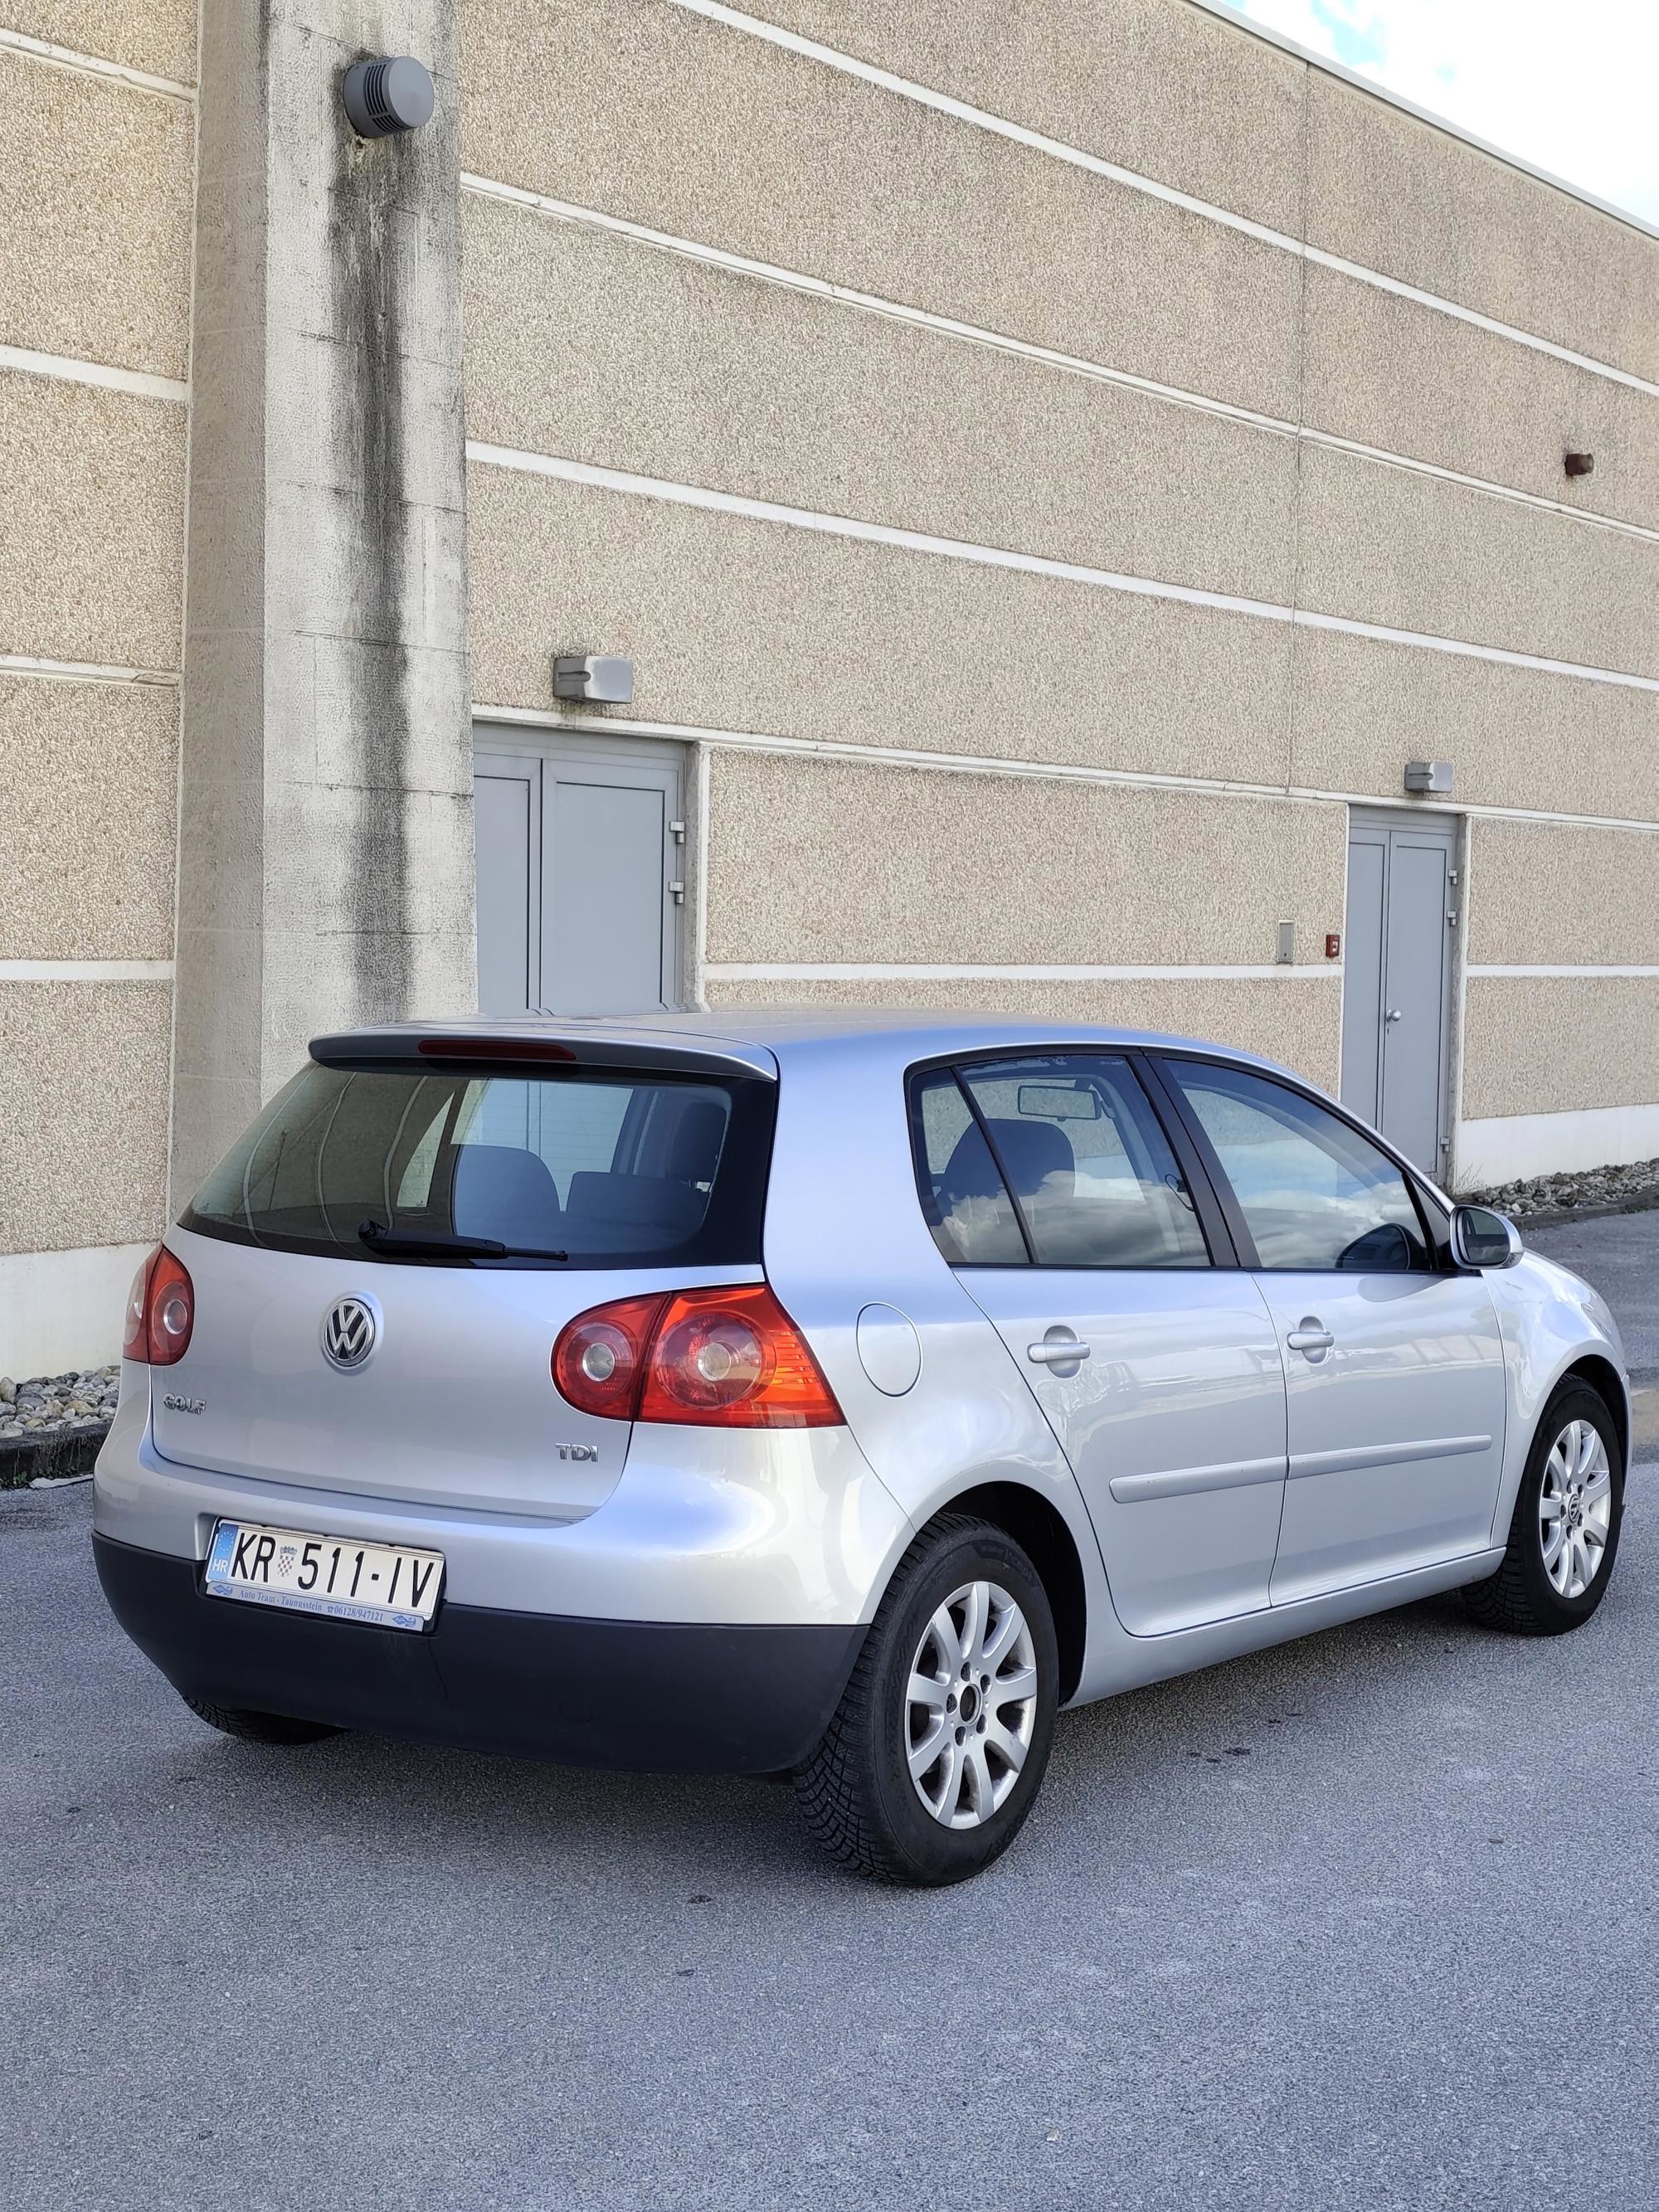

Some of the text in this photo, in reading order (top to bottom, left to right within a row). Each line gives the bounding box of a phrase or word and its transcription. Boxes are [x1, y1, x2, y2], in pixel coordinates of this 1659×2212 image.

[326, 1302, 372, 1364] VW
[163, 1393, 206, 1416] GOLF
[555, 1442, 598, 1462] TDI
[212, 1558, 229, 1573] HR
[231, 1532, 434, 1607] KR 511-IV
[239, 1590, 255, 1600] Auto
[257, 1592, 275, 1602] Team
[281, 1596, 322, 1612] Taunusstein
